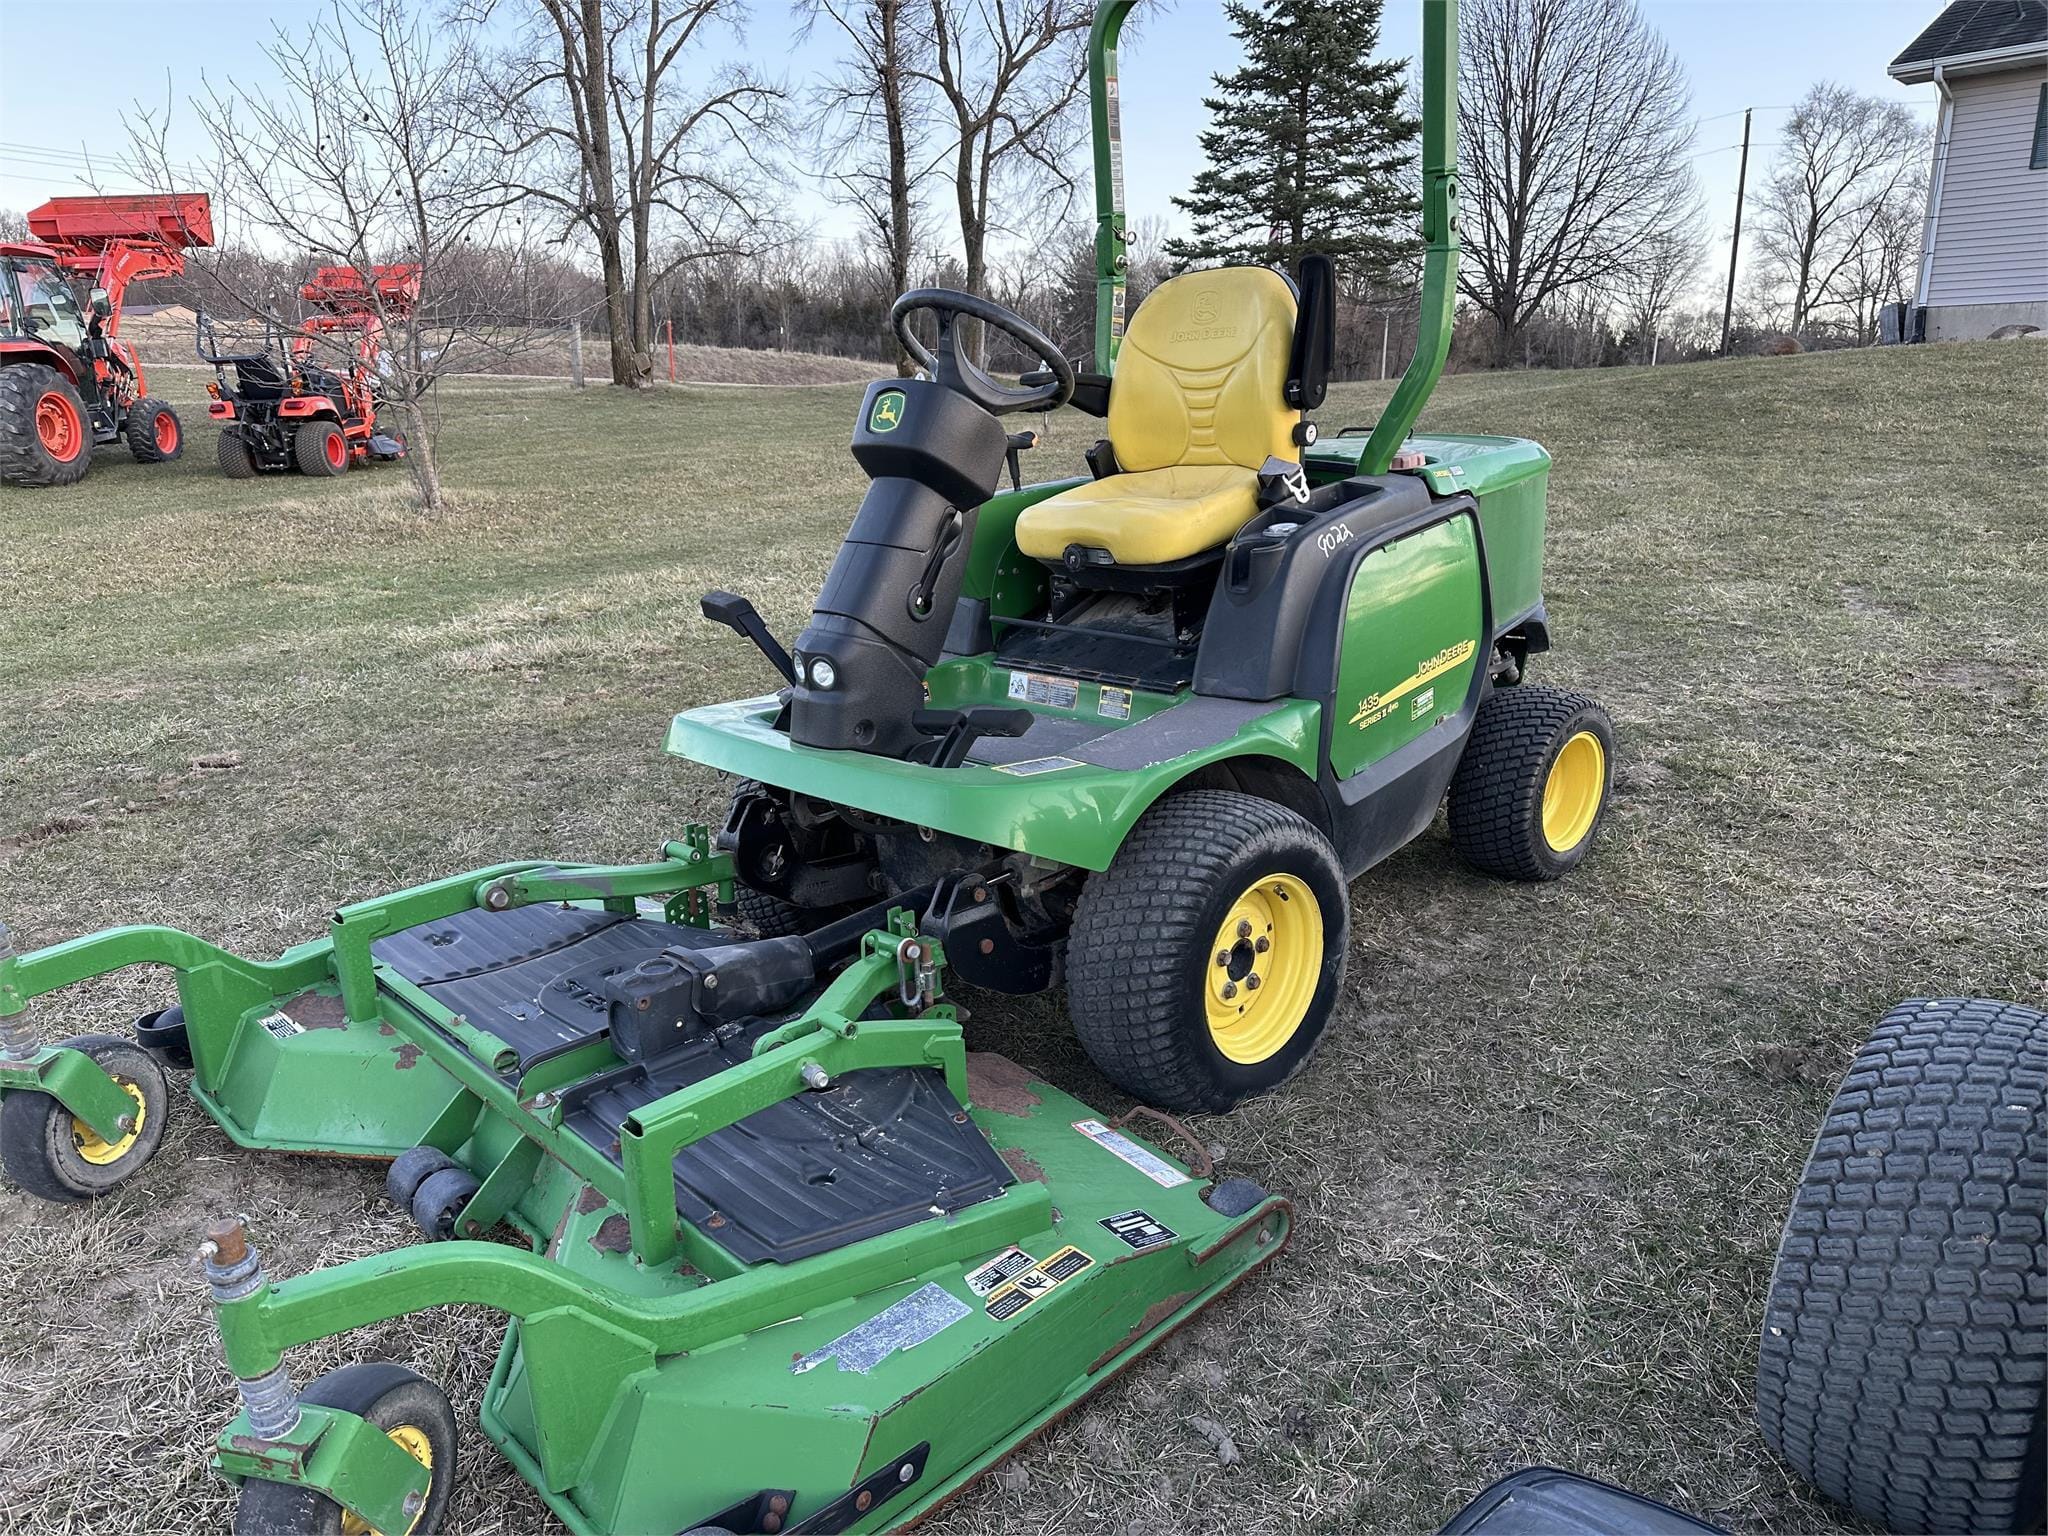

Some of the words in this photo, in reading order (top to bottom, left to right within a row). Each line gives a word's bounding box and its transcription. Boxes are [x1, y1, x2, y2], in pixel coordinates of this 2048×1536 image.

[1169, 329, 1199, 343] JOHN
[1201, 326, 1237, 340] DEERE
[1415, 655, 1440, 679] JOHN
[1440, 639, 1469, 665] DEERE
[1358, 692, 1380, 715] 1435
[1359, 711, 1382, 730] SERIES
